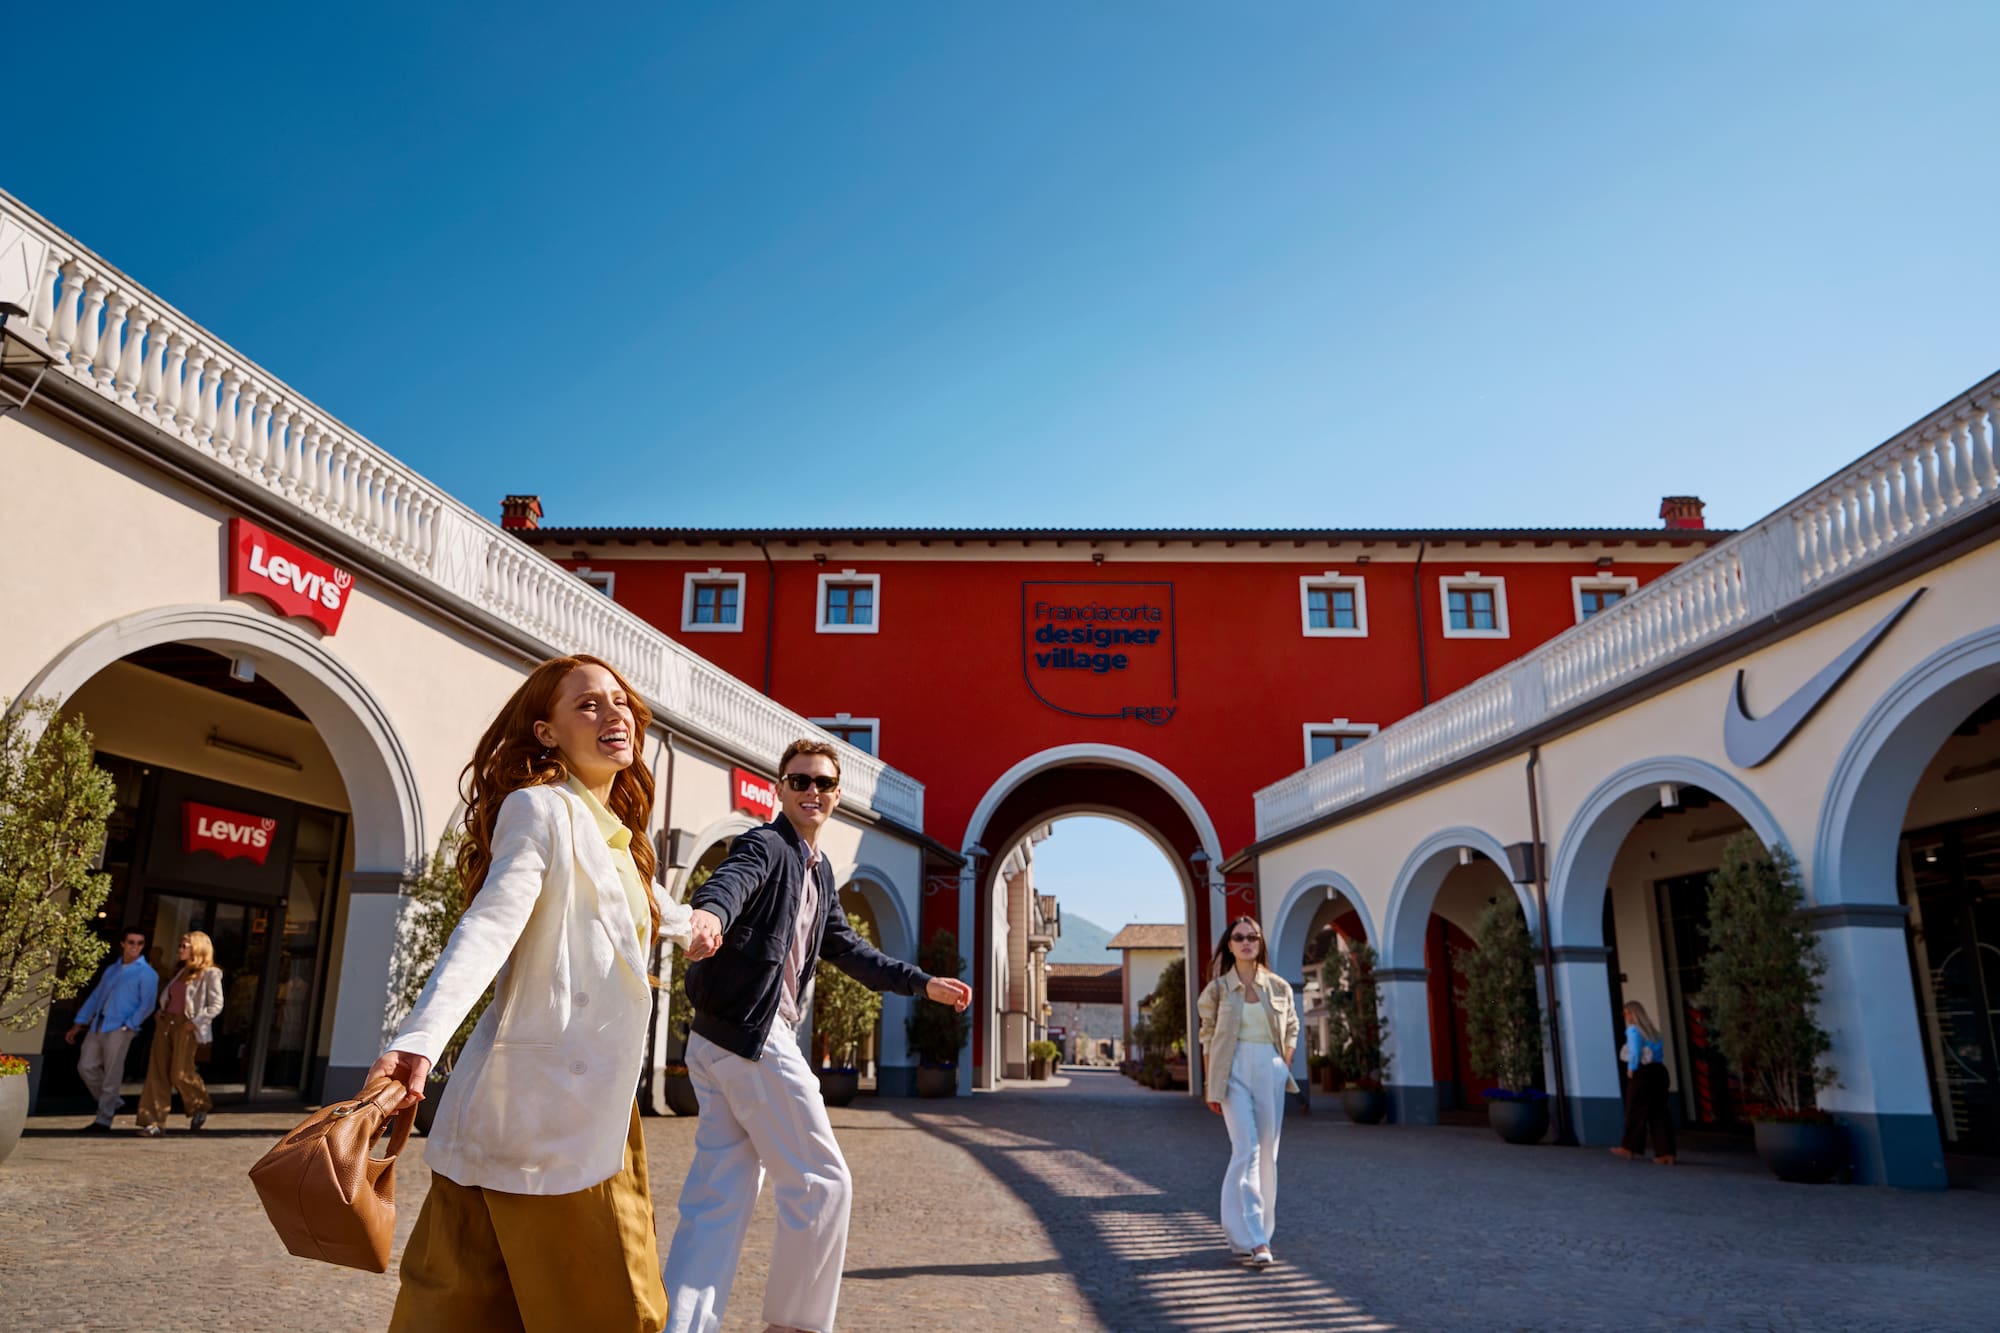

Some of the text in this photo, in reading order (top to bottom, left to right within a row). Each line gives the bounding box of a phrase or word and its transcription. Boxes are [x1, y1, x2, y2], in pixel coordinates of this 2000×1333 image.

[1035, 602, 1161, 621] Franciacorta
[1035, 624, 1160, 648] designer
[1035, 648, 1128, 673] village
[1121, 706, 1177, 725] FREY
